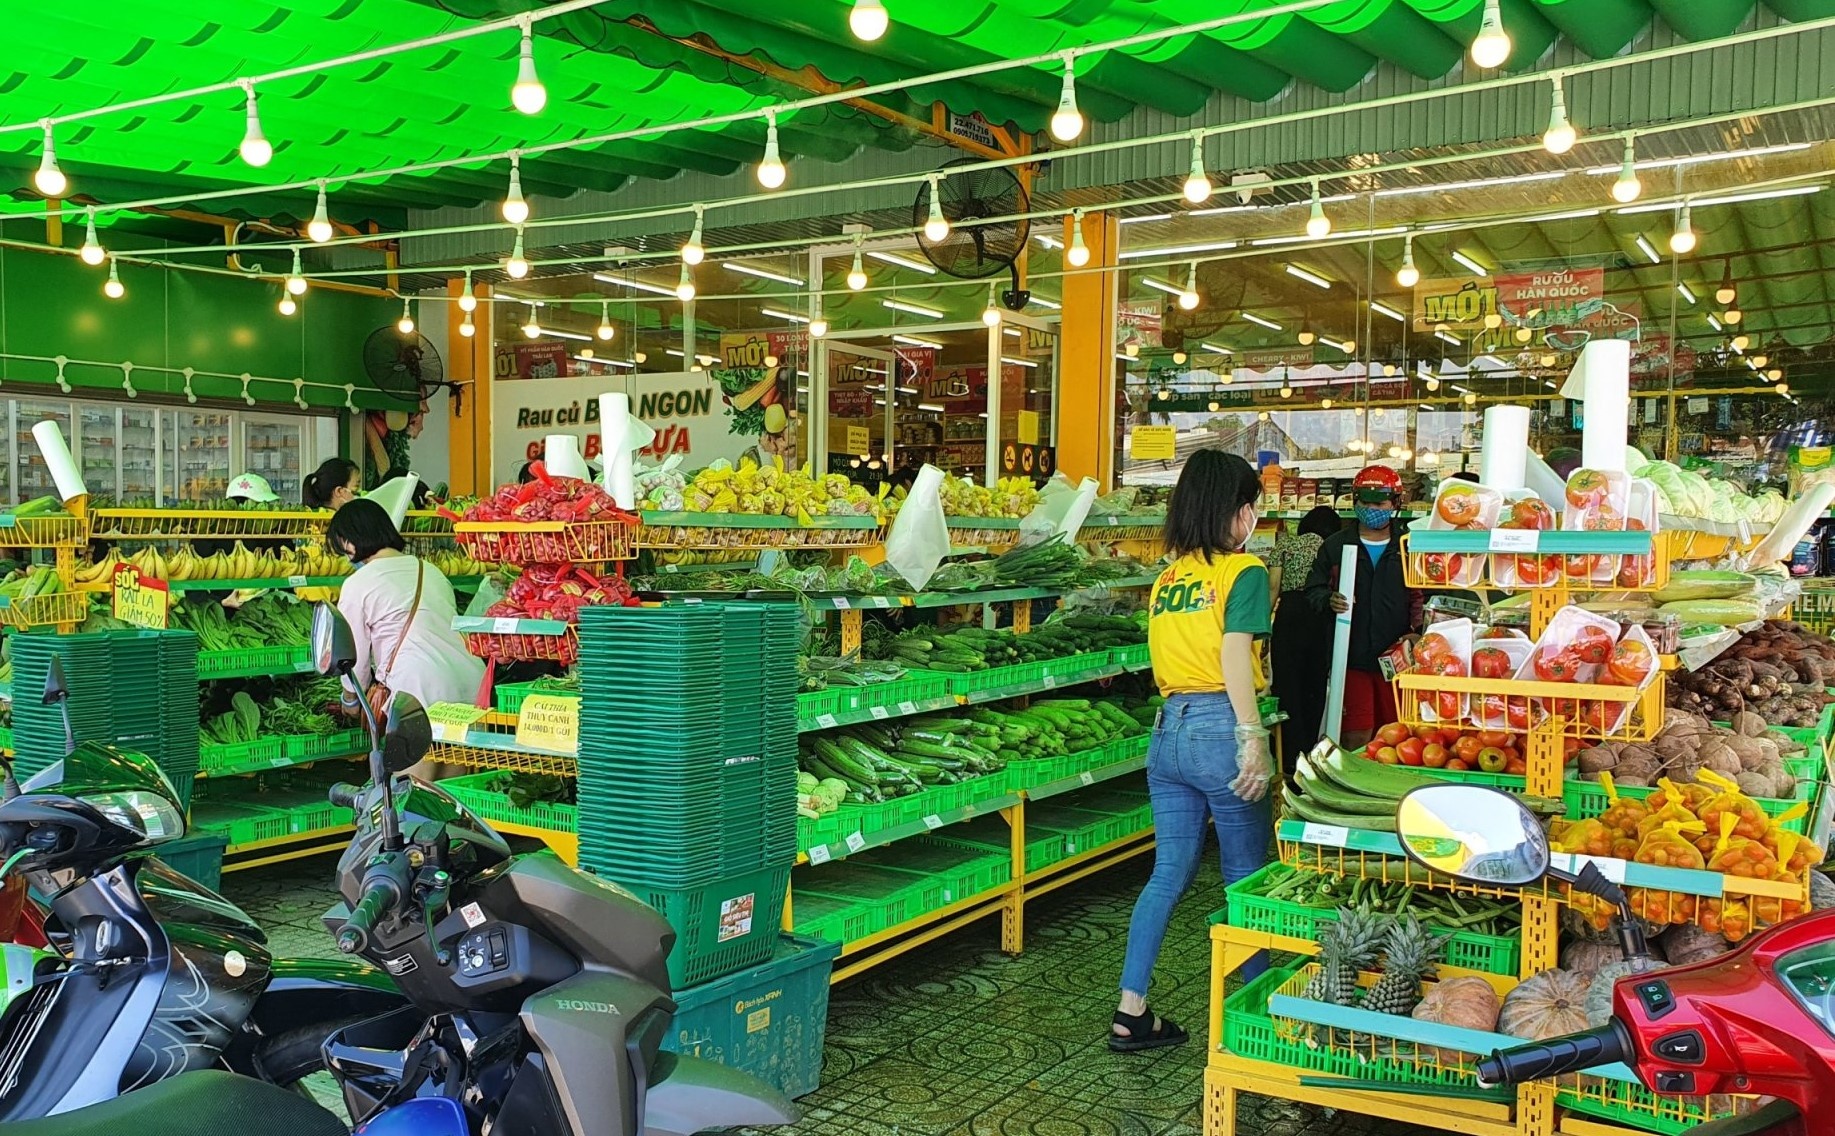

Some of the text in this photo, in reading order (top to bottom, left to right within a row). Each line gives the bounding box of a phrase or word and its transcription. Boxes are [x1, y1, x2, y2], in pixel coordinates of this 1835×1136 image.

[1425, 282, 1497, 323] MỚI
[1517, 281, 1589, 299] HÀN QUỐC
[493, 348, 519, 377] ỚI
[727, 336, 770, 368] MỚI
[1252, 355, 1284, 363] CHERRY
[1290, 353, 1310, 362] KIWI
[517, 407, 553, 428] Rau
[557, 401, 581, 424] củ
[639, 388, 713, 418] NGON
[115, 565, 140, 592] SỐC
[1154, 572, 1203, 616] SỐC
[548, 714, 570, 724] CANH
[556, 999, 621, 1016] HONDA
